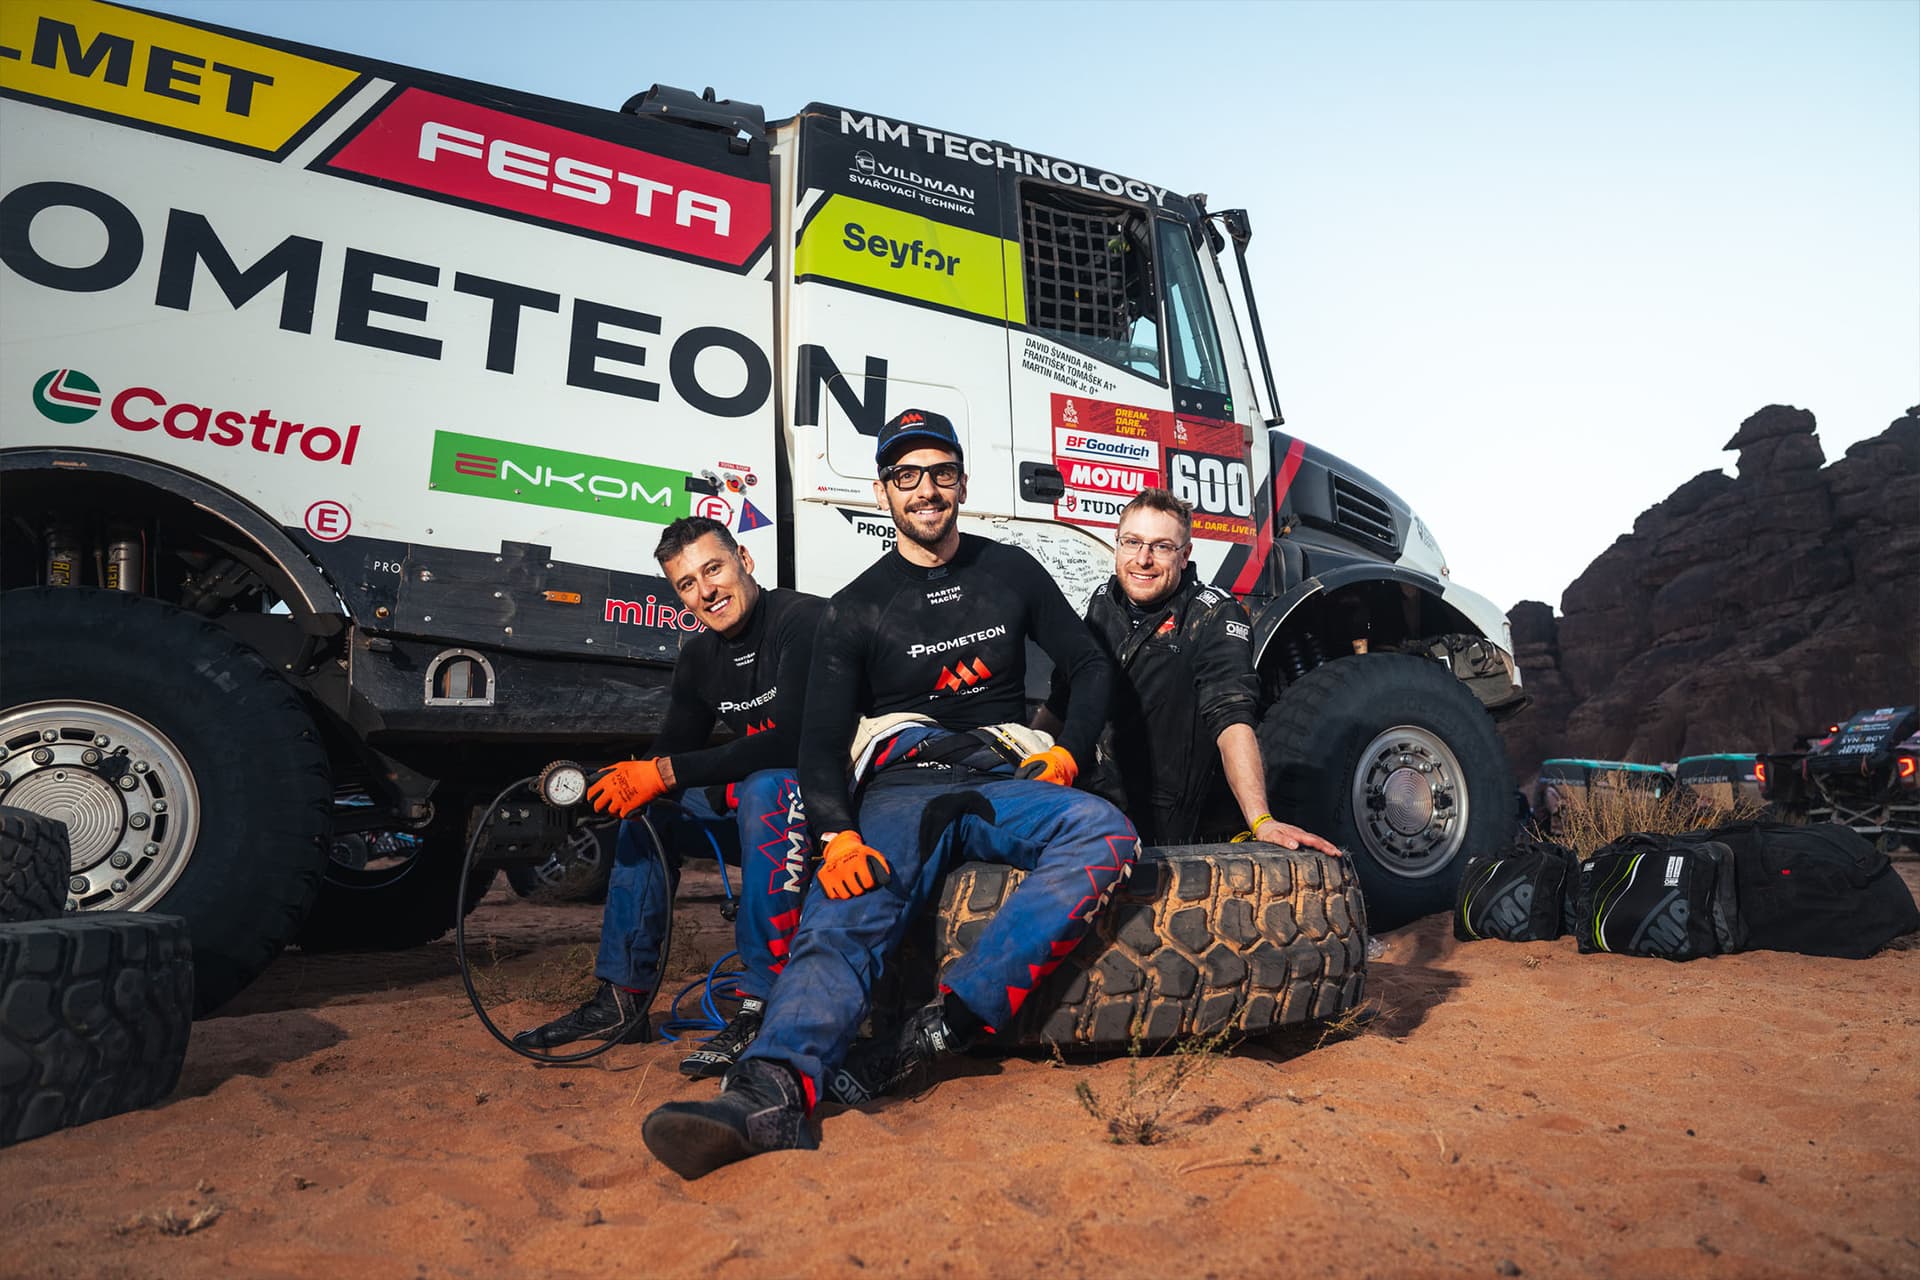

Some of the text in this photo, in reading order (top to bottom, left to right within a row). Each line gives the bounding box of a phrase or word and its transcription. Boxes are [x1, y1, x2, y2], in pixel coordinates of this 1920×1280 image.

[841, 110, 1169, 208] MM TECHNOLOGY
[418, 121, 733, 237] FESTA
[878, 163, 975, 200] VILDMAN
[848, 173, 976, 216] SVAŘOVACÍ TECHNIKA
[842, 222, 960, 277] Seyfor
[1023, 348, 1066, 372] FRANTIŠEK
[1025, 337, 1050, 354] DAVID
[1050, 346, 1082, 368] ŠVANDA
[1021, 359, 1053, 378] MARTIN
[110, 386, 362, 466] Castrol
[1115, 407, 1150, 422] DREAM.
[1115, 416, 1142, 428] DARE.
[1115, 425, 1136, 436] LIVE
[1066, 435, 1150, 457] BFGoodrich
[454, 452, 672, 507] ENKOM
[1070, 464, 1146, 492] MOTUL
[1171, 453, 1252, 517] 600
[318, 508, 338, 532] E
[1204, 522, 1230, 532] DARE.
[1231, 524, 1249, 535] LIVE
[926, 585, 961, 599] MARTIN
[907, 624, 1006, 658] PROMETEON
[1225, 622, 1250, 637] OMP
